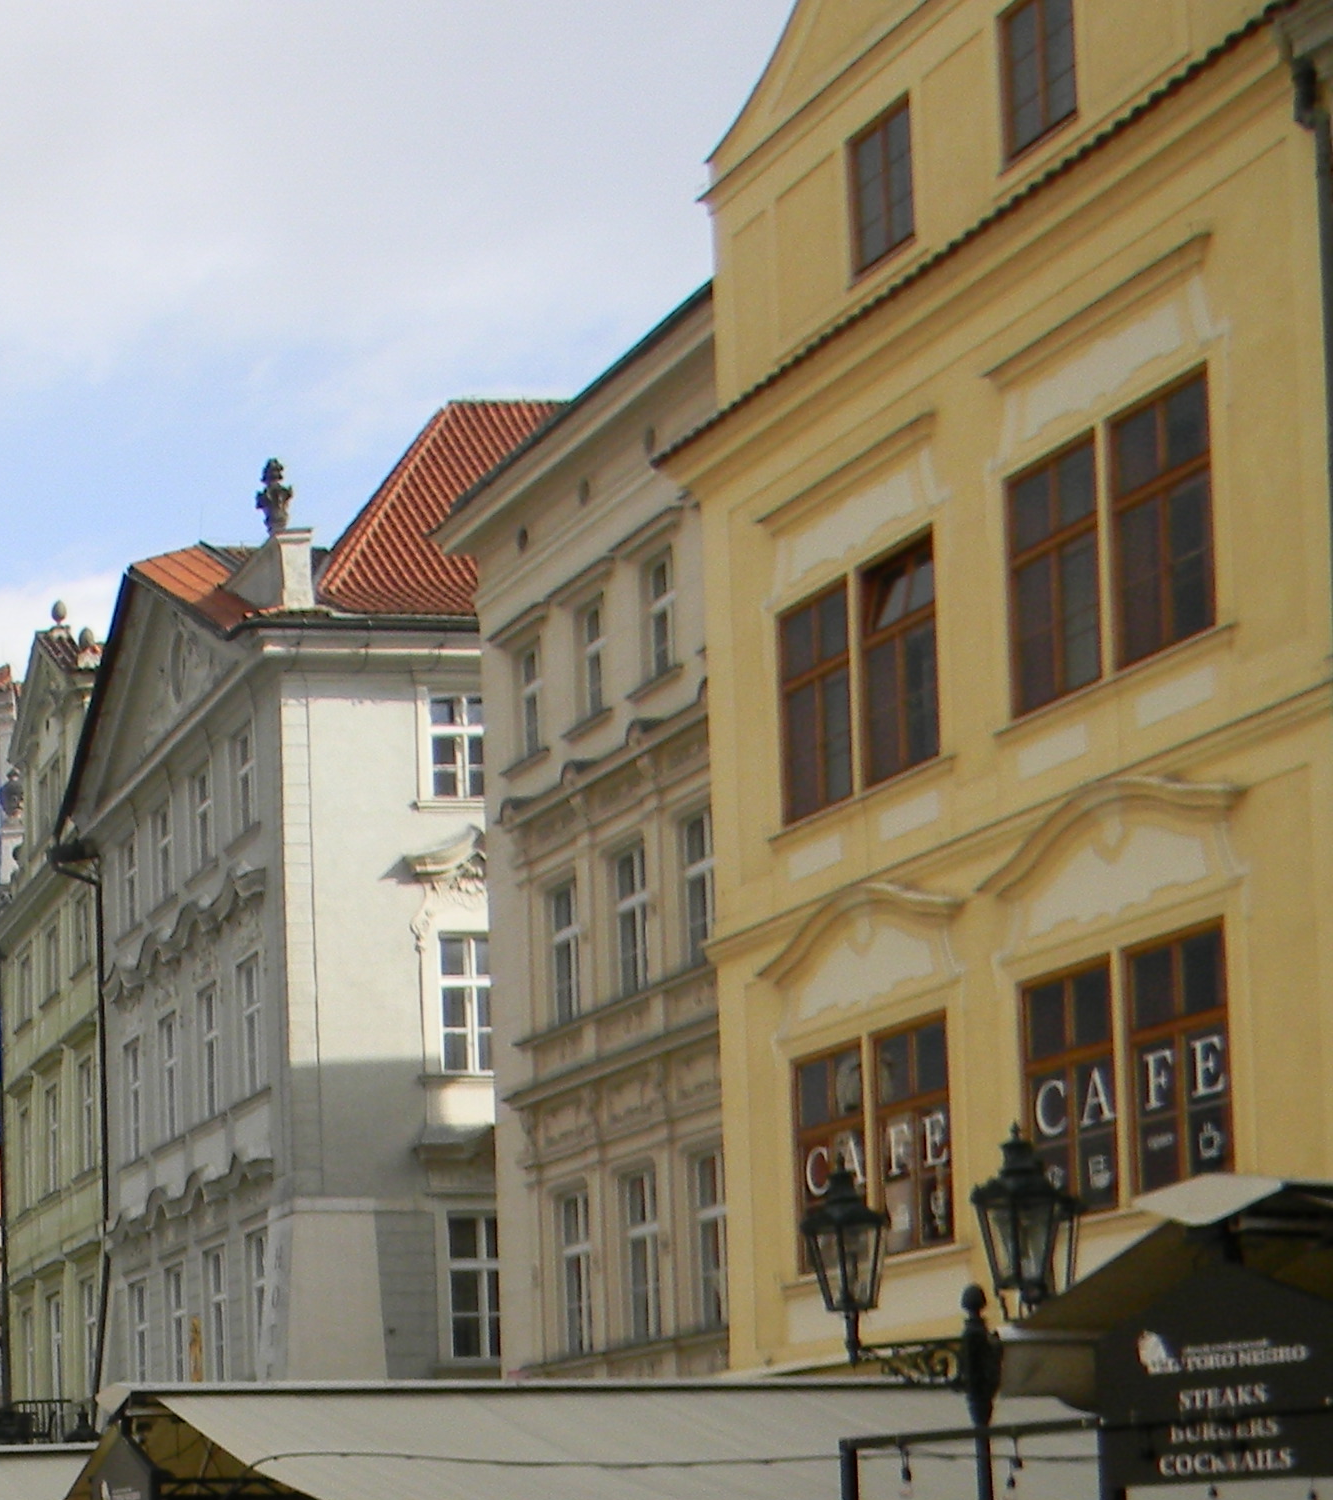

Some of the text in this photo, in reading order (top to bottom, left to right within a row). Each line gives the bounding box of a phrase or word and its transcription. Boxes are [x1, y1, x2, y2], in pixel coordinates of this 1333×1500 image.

[1035, 1034, 1226, 1137] CAFE
[1183, 1352, 1236, 1373] TORO
[1237, 1344, 1308, 1367] NEGRO
[1179, 1383, 1269, 1411] STEAKS
